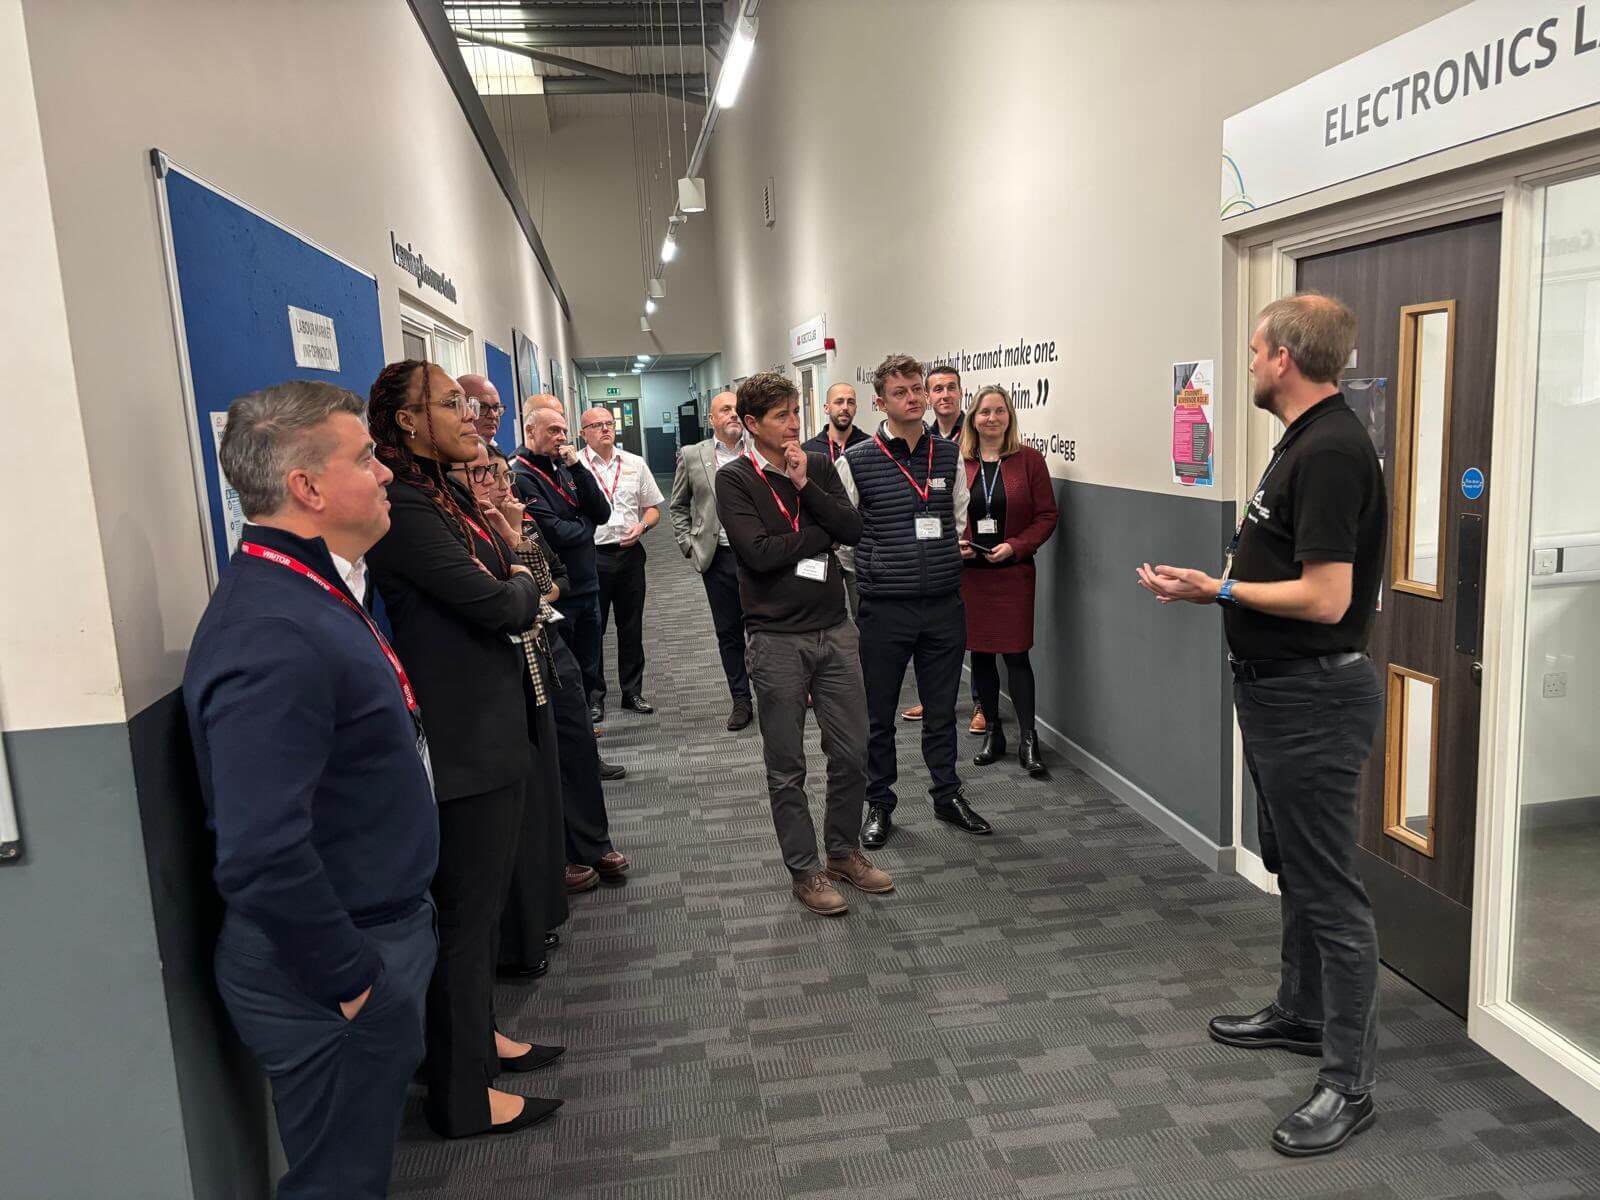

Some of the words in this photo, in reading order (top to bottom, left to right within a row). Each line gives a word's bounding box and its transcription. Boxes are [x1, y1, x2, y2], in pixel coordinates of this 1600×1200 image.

[1325, 17, 1558, 147] ELECTRONICS
[1574, 4, 1600, 56] L
[961, 348, 972, 373] he
[973, 343, 1002, 371] cannot
[1004, 337, 1032, 367] make
[1034, 340, 1058, 364] one.
[1050, 433, 1076, 461] Glegg
